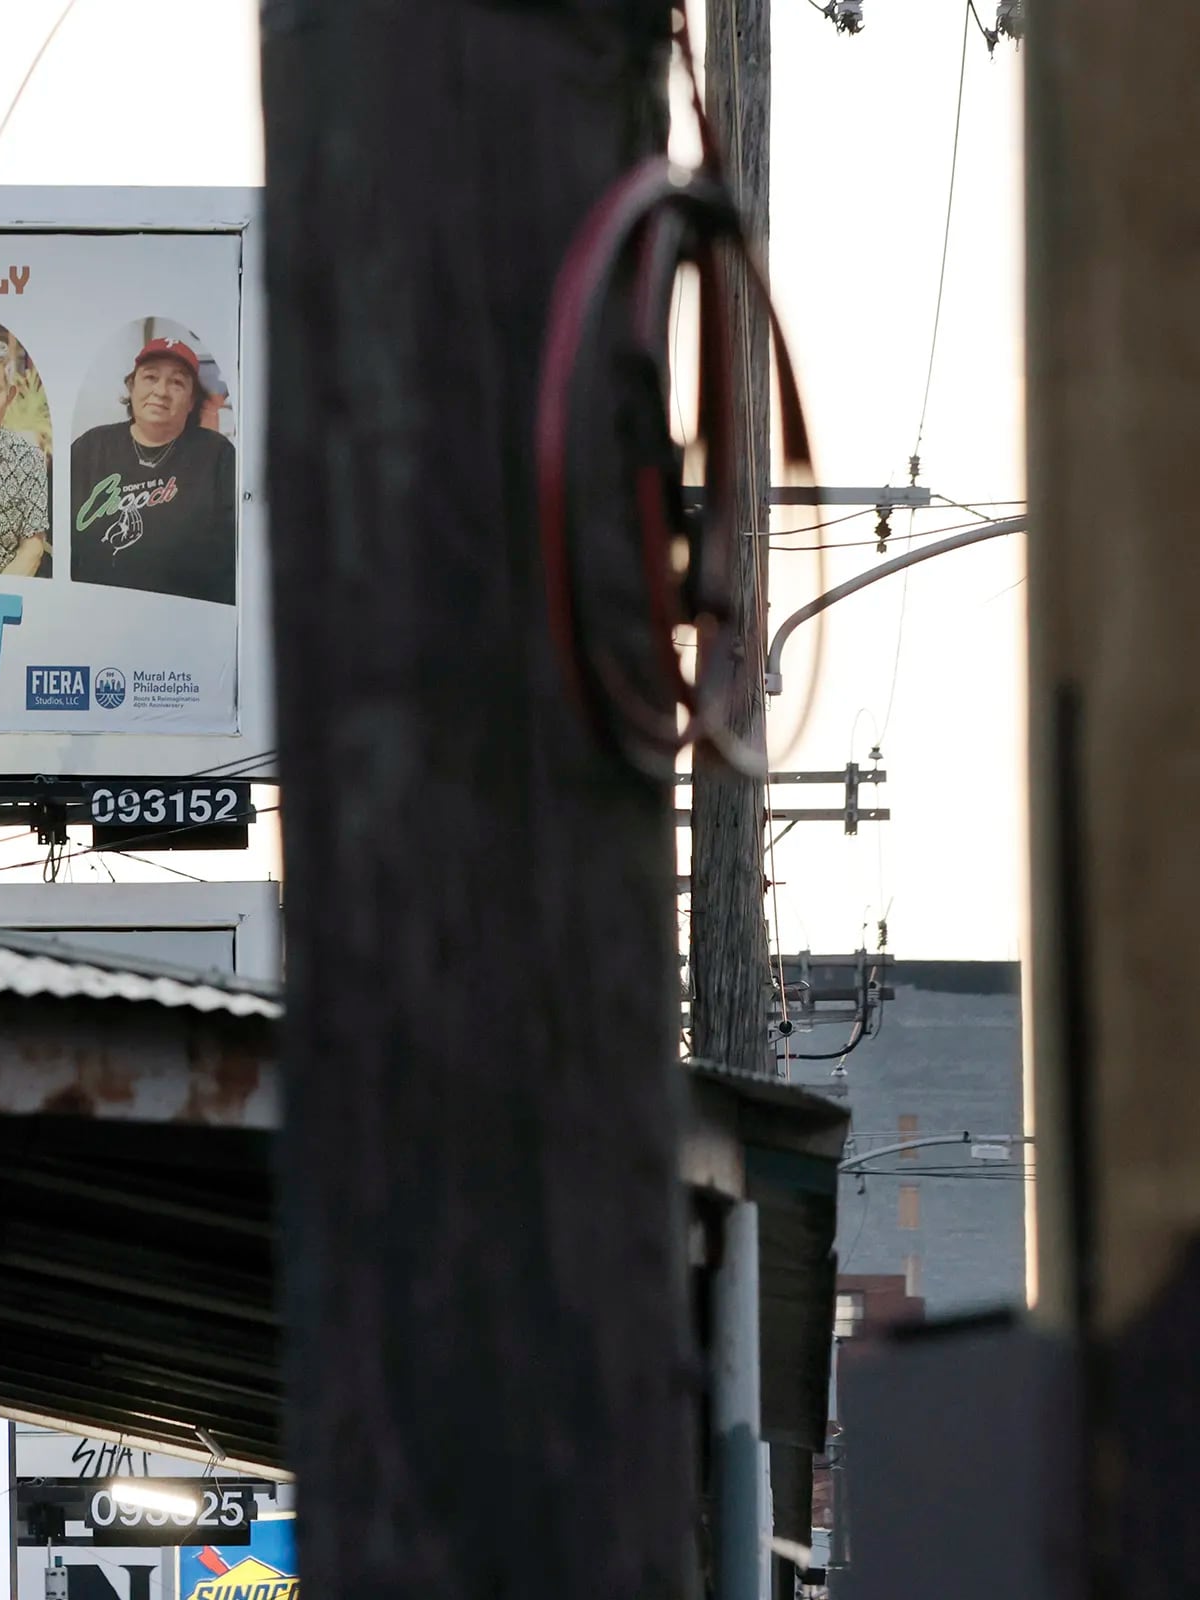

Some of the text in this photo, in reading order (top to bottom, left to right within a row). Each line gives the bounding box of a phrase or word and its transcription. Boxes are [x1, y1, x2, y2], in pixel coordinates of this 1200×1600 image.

[133, 670, 192, 681] Mural Arts
[31, 670, 85, 695] FIERA
[133, 682, 200, 695] Philadelphia
[66, 697, 80, 705] LLC
[91, 788, 238, 823] 093152
